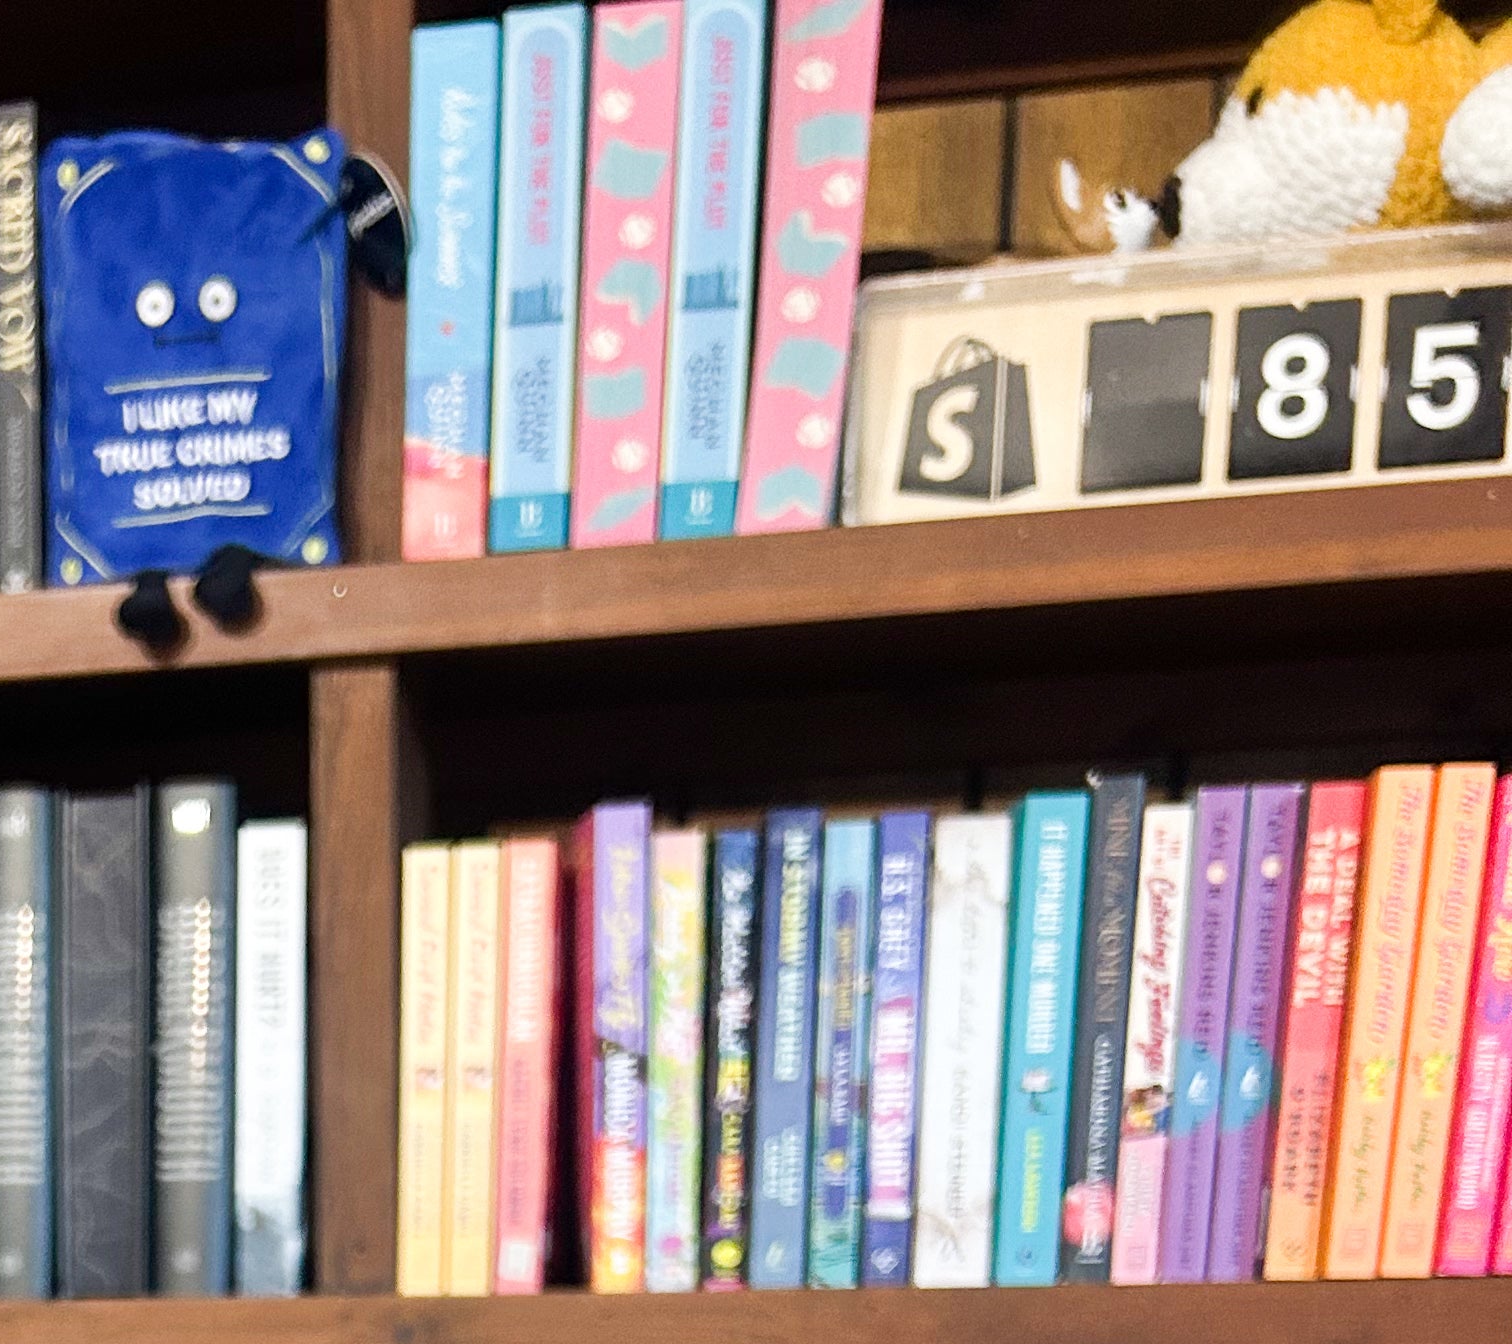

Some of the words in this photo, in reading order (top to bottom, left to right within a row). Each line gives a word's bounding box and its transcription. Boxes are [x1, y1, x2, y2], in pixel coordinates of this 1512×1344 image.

[139, 395, 207, 431] LIKE
[207, 388, 258, 425] MY
[93, 438, 175, 477] TRUE
[176, 428, 290, 466] CRIMES
[134, 471, 251, 510] SOLVED
[1034, 846, 1065, 936] HAPPENED
[1307, 828, 1336, 894] THE
[1331, 861, 1357, 928] DEAL
[1139, 877, 1179, 968] Catching
[1293, 906, 1329, 1008] DEVIL
[1323, 935, 1351, 1006] WITH
[1025, 979, 1059, 1054] MURDER
[1135, 977, 1172, 1073] Feelings
